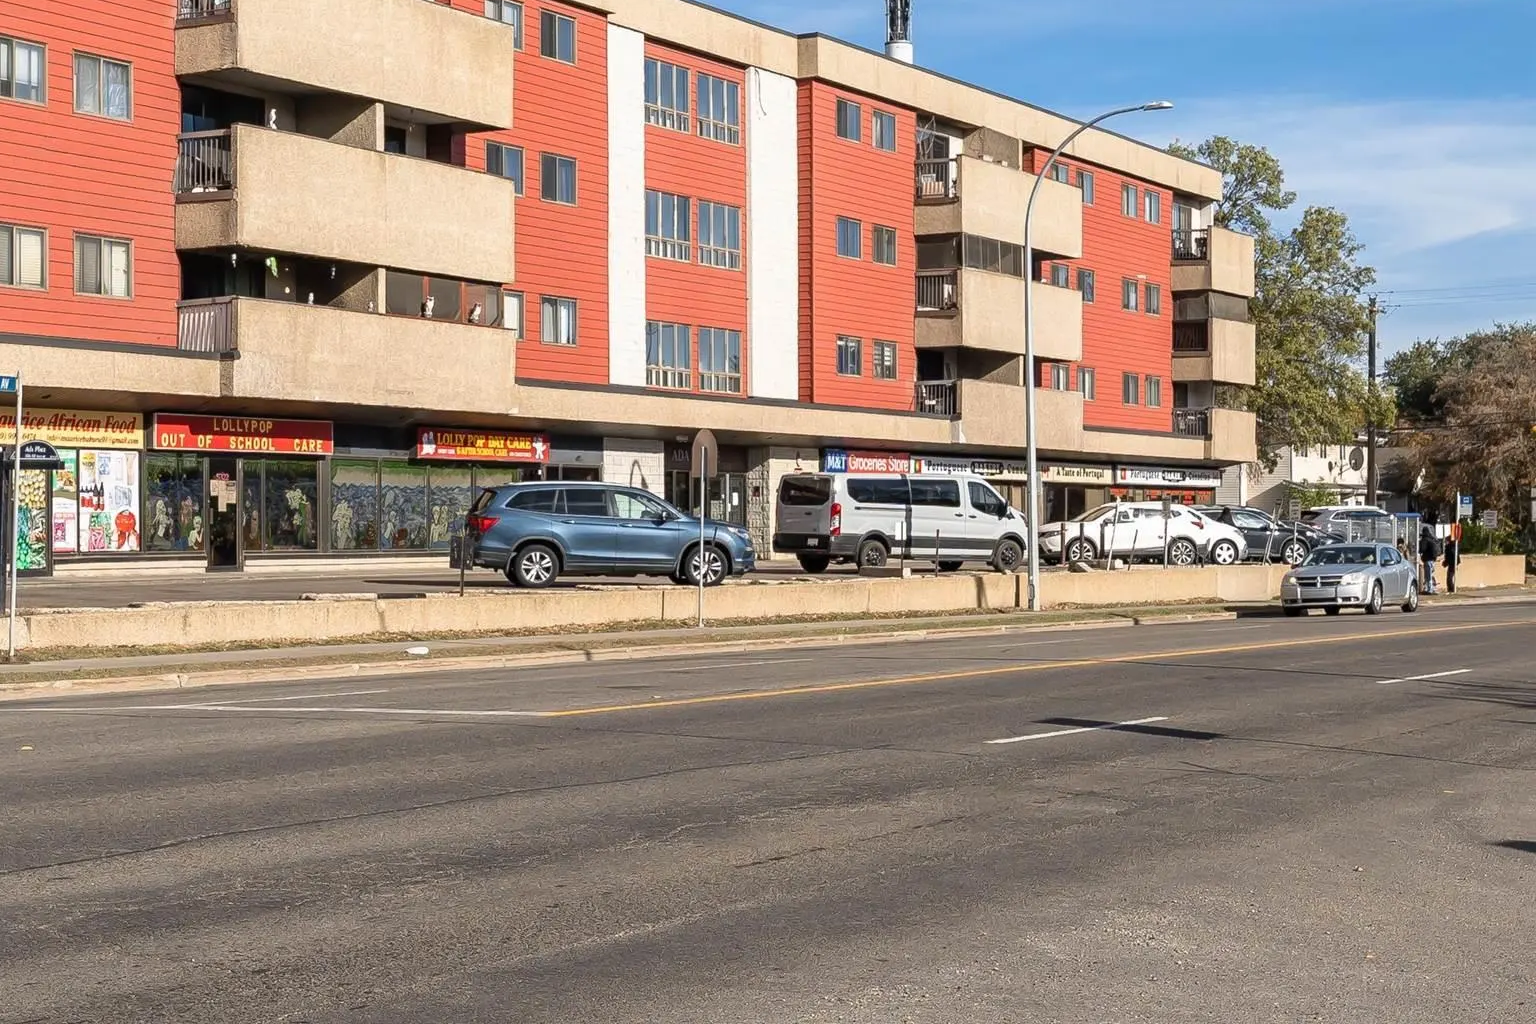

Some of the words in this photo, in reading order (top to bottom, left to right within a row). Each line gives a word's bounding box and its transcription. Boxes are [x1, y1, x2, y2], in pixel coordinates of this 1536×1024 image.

[0, 378, 10, 390] AV
[46, 413, 103, 433] African
[104, 416, 136, 434] Food
[214, 417, 273, 433] LOLLYPOP
[161, 433, 185, 447] OUT
[197, 435, 213, 449] OF
[230, 437, 275, 451] SCHOOL
[293, 439, 323, 452] CARE
[437, 433, 465, 446] LOLLY
[467, 435, 486, 447] POP
[488, 436, 504, 449] DAY
[507, 437, 532, 449] CARE
[672, 448, 690, 462] ADA
[827, 454, 846, 469] M&T
[849, 454, 887, 470] Groceries
[889, 456, 908, 471] Store
[927, 460, 967, 474] Portuguese
[1083, 466, 1104, 480] Portugal
